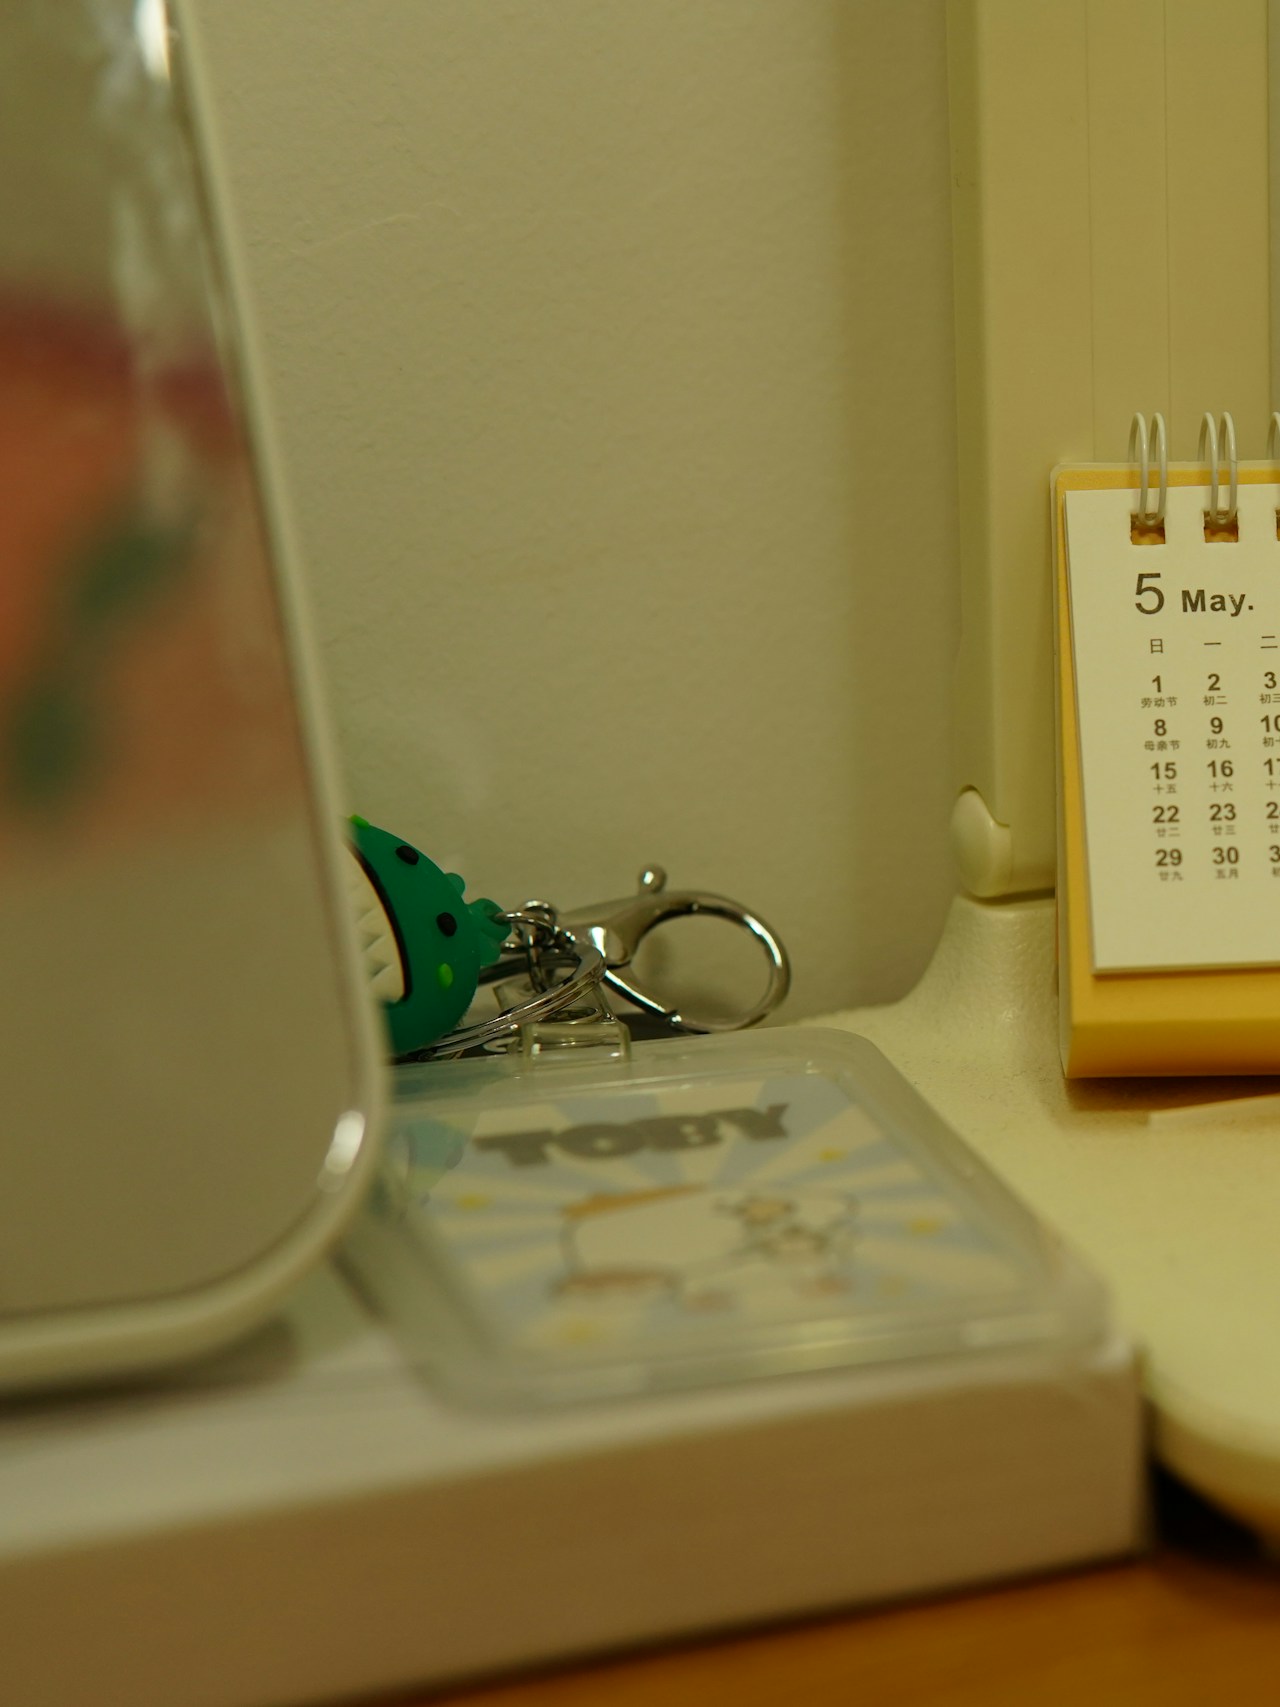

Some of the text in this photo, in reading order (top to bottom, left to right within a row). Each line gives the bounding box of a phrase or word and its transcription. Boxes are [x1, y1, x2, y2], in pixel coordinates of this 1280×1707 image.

[1134, 572, 1165, 615] 5
[1181, 589, 1254, 618] May.
[1149, 638, 1164, 655] 日
[1259, 635, 1279, 649] 二
[1151, 675, 1162, 694] 1
[1207, 673, 1221, 692] 2
[1263, 671, 1277, 690] 3
[1140, 695, 1178, 709] 劳动节
[1202, 695, 1228, 707] 初二
[1153, 718, 1168, 737] 8
[1209, 716, 1224, 735] 9
[1143, 739, 1181, 752] 母亲节
[1205, 737, 1231, 750] 初九
[1150, 761, 1177, 781] 15
[1207, 759, 1234, 779] 16
[1153, 783, 1177, 795] 十五
[1209, 781, 1234, 793] 十六
[1152, 804, 1180, 824] 22
[1209, 802, 1237, 822] 23
[1155, 826, 1181, 838] 廿二
[1211, 824, 1236, 836] 廿三
[1155, 848, 1183, 867] 29
[1212, 846, 1240, 866] 30
[472, 1103, 789, 1168] TOBY
